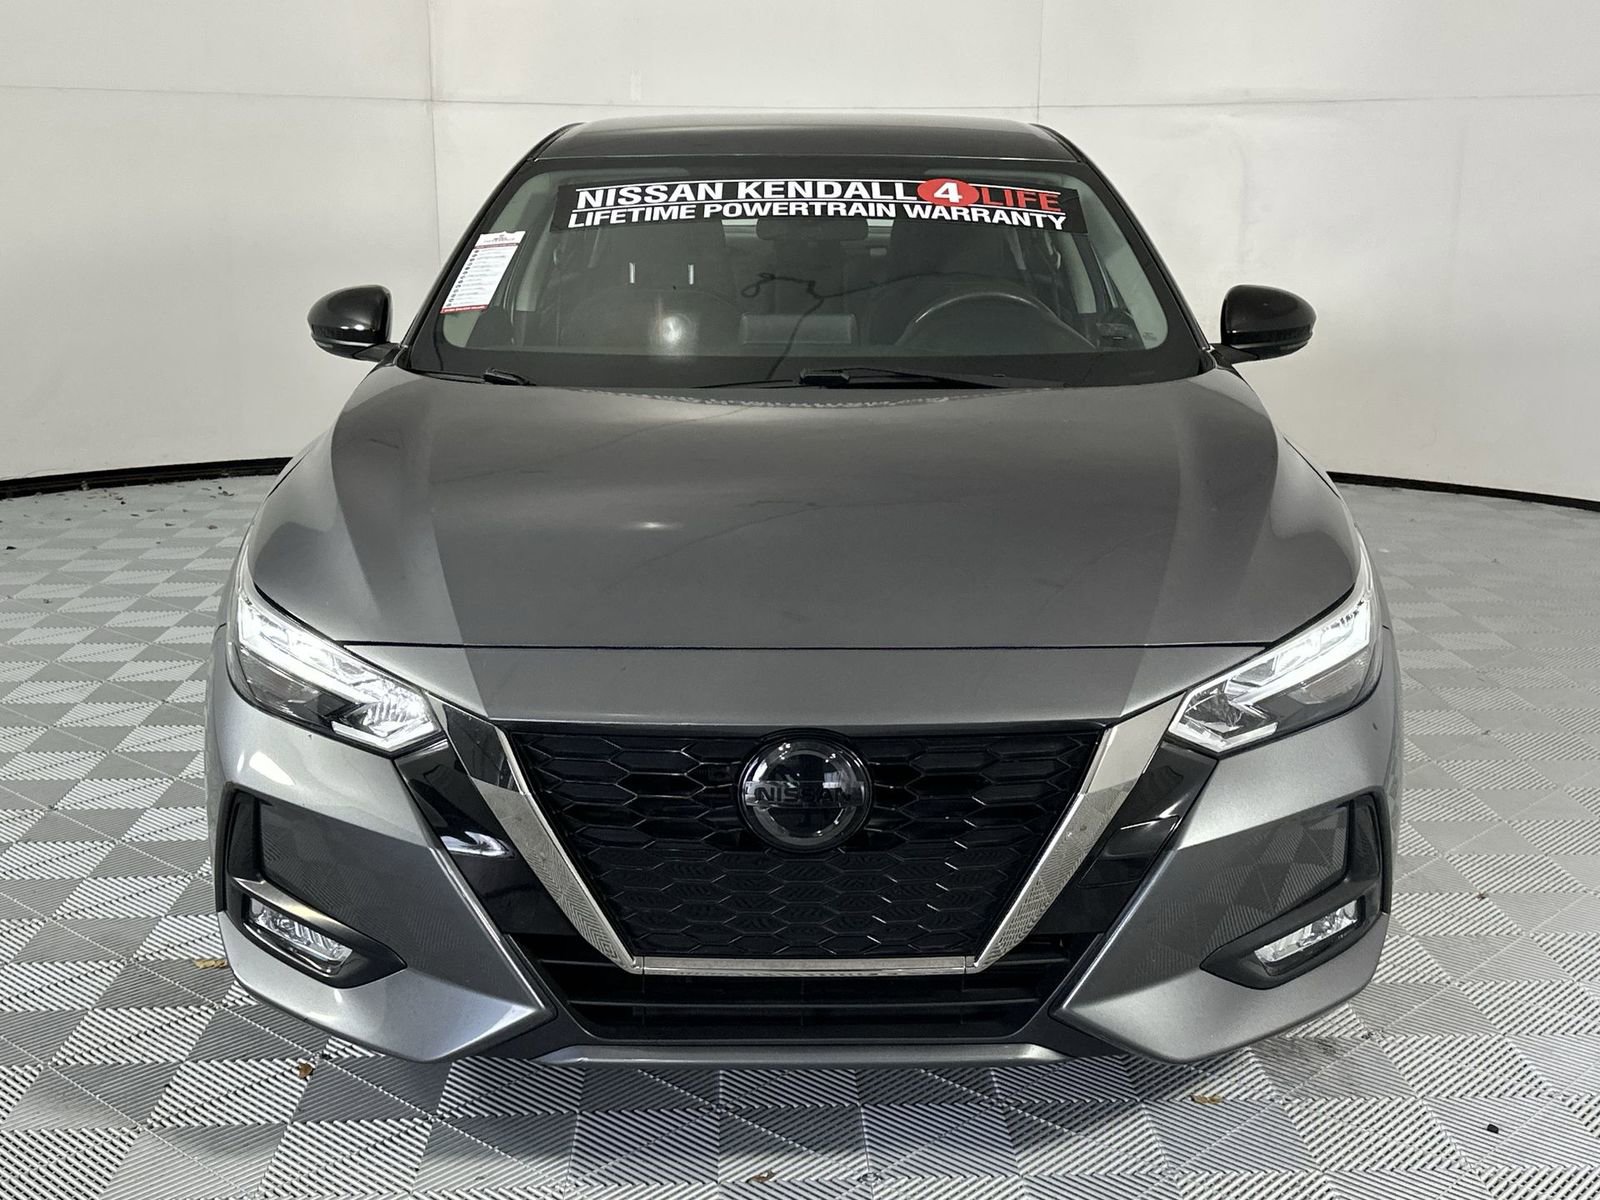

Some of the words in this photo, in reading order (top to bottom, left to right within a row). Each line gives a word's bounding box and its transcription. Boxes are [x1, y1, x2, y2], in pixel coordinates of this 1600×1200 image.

[577, 184, 723, 208] NISSAN
[737, 181, 918, 201] KENDALL
[933, 182, 963, 203] 4
[981, 188, 1061, 212] LIFE
[568, 205, 696, 229] LIFETIME
[703, 202, 895, 219] POWERTRAIN
[903, 204, 1067, 231] WARRANTY
[754, 786, 851, 803] NISSAN
